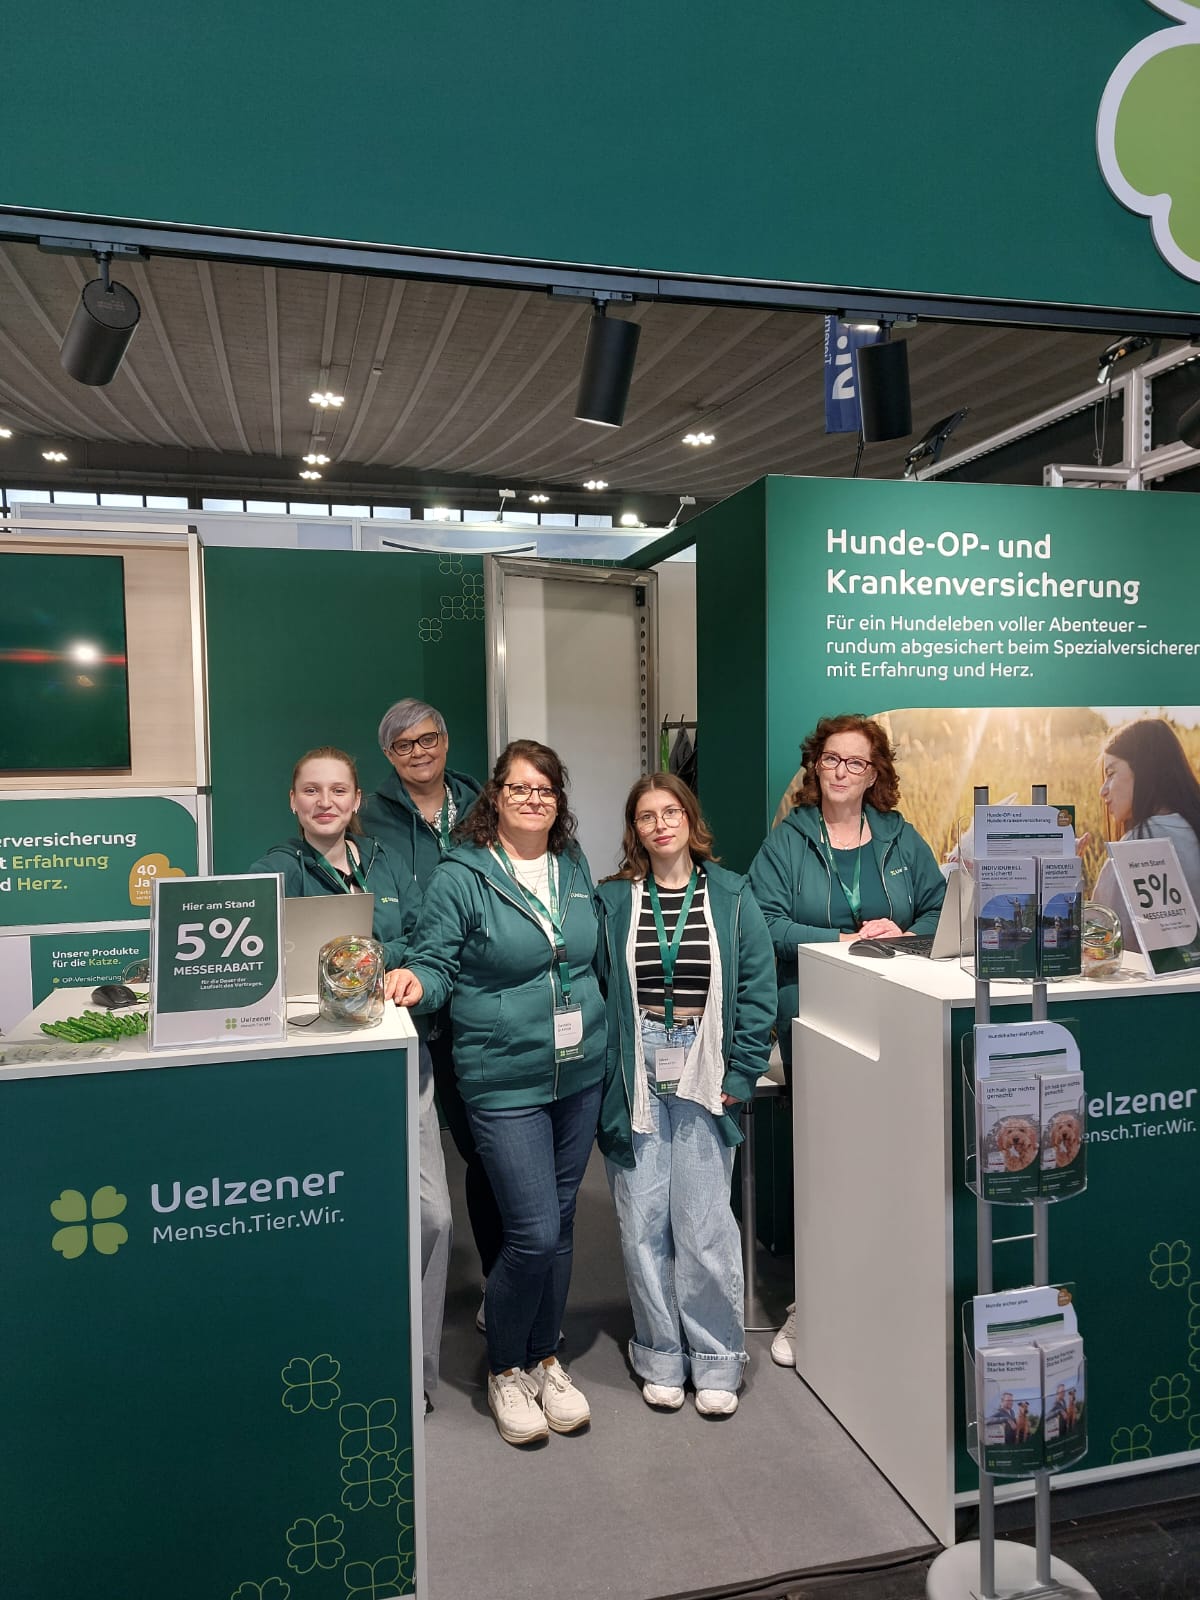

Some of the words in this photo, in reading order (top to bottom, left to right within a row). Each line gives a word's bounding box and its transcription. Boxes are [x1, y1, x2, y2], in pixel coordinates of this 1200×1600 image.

[827, 529, 990, 556] Hunde-OP-
[999, 534, 1051, 558] und
[827, 569, 1140, 604] Krankenversicherung
[827, 614, 855, 631] Für
[859, 616, 885, 631] ein
[891, 616, 994, 632] Hundeleben
[998, 617, 1045, 632] voller
[827, 641, 896, 654] rundum
[901, 639, 1004, 658] abgesichert
[1008, 640, 1049, 655] beim
[1053, 639, 1200, 658] Spezialversicherer
[827, 662, 856, 677] mit
[861, 662, 948, 681] Erfahrung
[953, 662, 985, 677] und
[990, 663, 1034, 678] Herz.
[12, 854, 109, 870] Erfahrung
[136, 864, 157, 876] 40
[17, 877, 68, 891] Herz.
[134, 876, 154, 888] Ja
[1133, 873, 1182, 909] 5%
[182, 902, 204, 911] Hier
[206, 902, 222, 910] am
[225, 899, 256, 909] Stand
[1142, 908, 1187, 920] MESSERABATT
[175, 916, 264, 961] 5%
[52, 950, 89, 959] Unsere
[92, 947, 140, 957] Produkte
[52, 959, 68, 968] für
[70, 958, 86, 967] die
[89, 957, 121, 966] Katze.
[173, 961, 264, 976] MESSERABATT
[1088, 1088, 1198, 1118] elzener
[1080, 1118, 1197, 1143] ensch.Tier.Wir.
[150, 1170, 345, 1213] Uelzener
[152, 1205, 345, 1244] Mensch.Tier.Wir.
